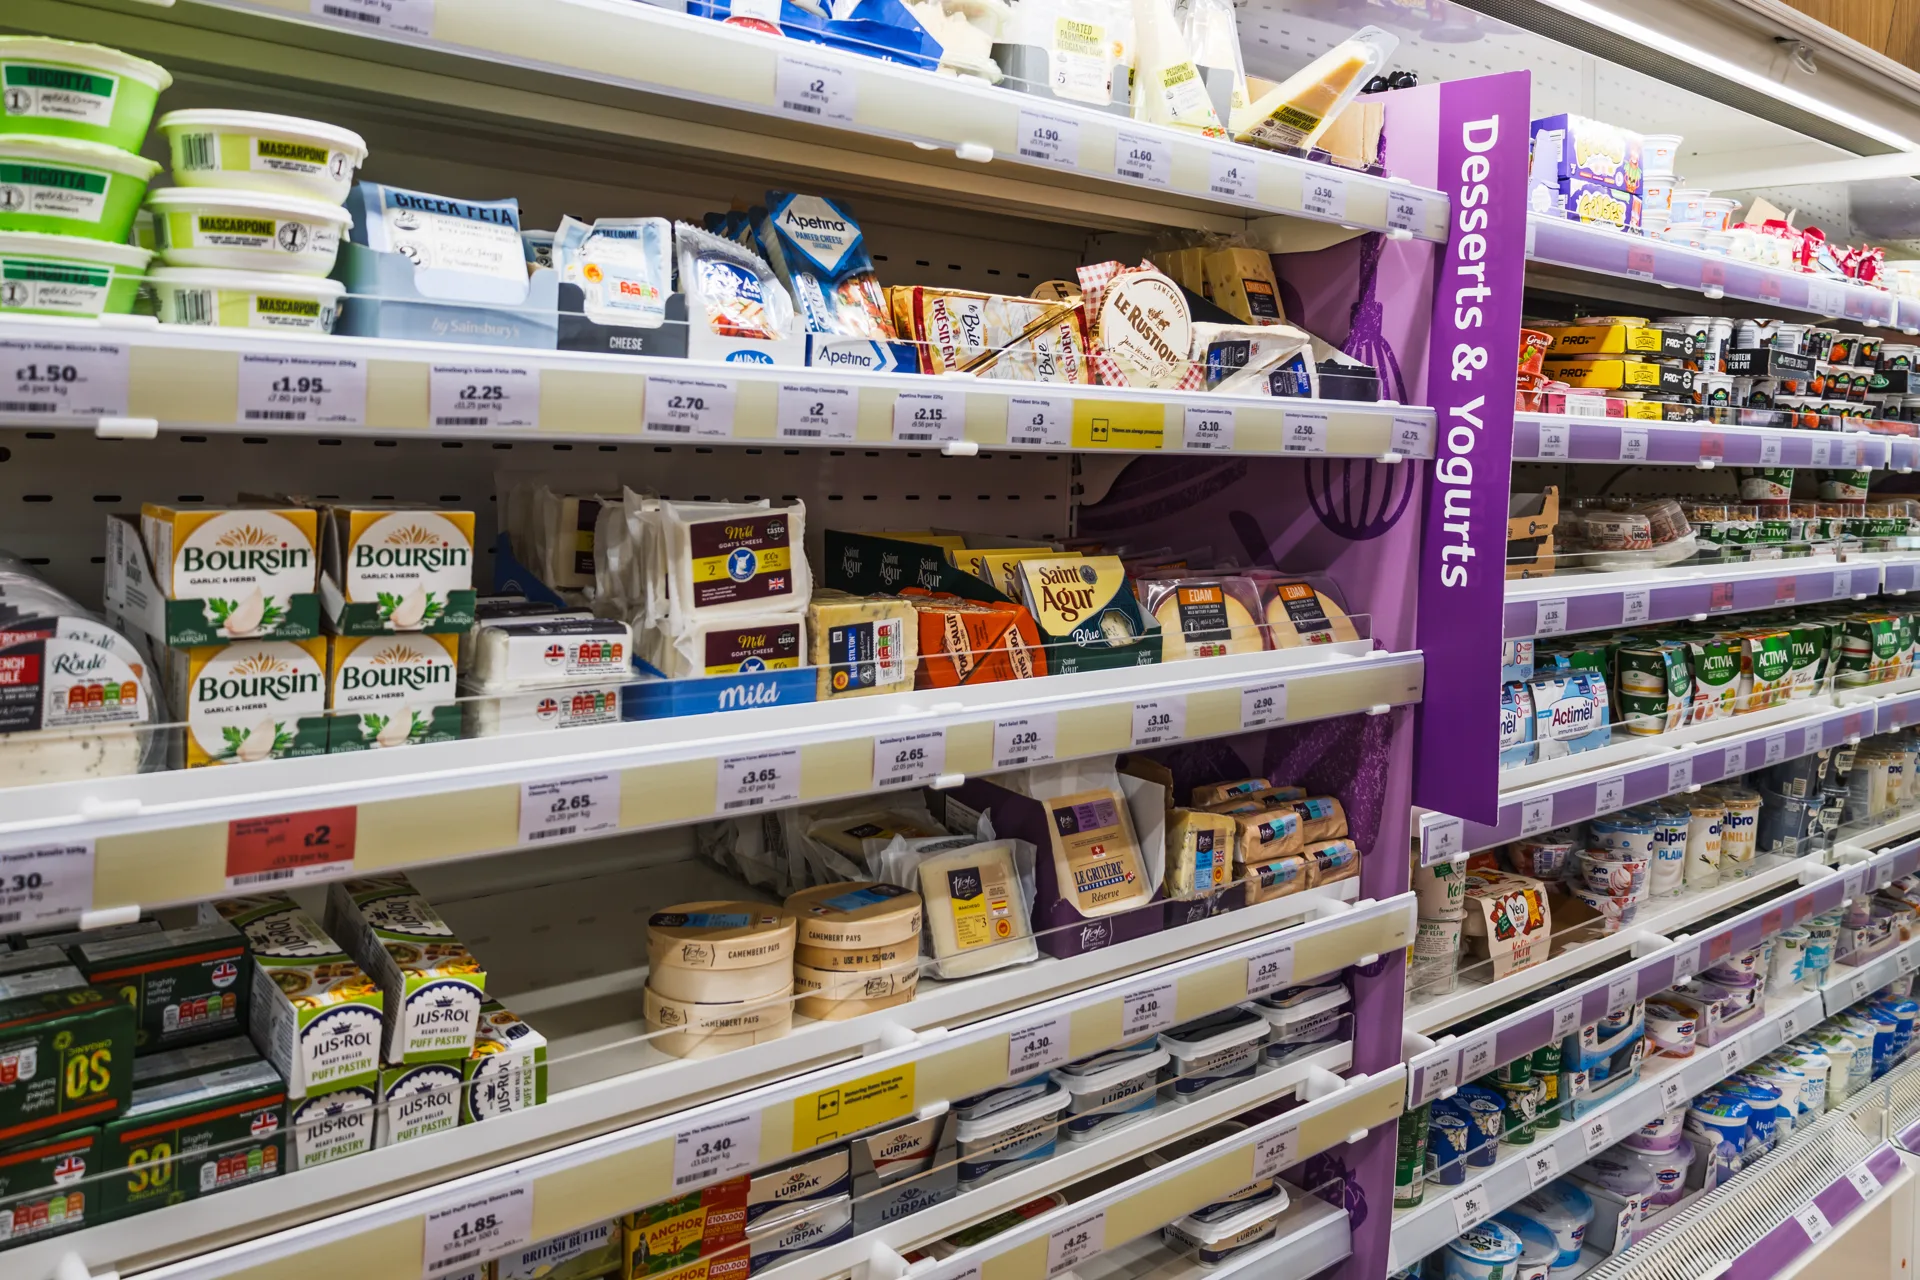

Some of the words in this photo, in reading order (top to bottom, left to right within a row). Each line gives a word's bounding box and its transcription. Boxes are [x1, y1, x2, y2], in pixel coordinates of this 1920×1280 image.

[1067, 21, 1092, 34] GRATED
[27, 67, 94, 93] RICOTTA
[810, 79, 824, 93] £2
[1034, 129, 1059, 142] £1.90
[258, 141, 328, 163] MASCARPONE
[1130, 148, 1152, 163] £1.60
[22, 165, 86, 190] RICOTTA
[1227, 167, 1237, 179] £4
[1314, 187, 1332, 198] £3.50
[200, 218, 274, 235] MASCARPONE
[786, 209, 846, 232] Apetina
[1454, 114, 1500, 330] Desserts
[795, 231, 819, 243] PANEER
[820, 234, 843, 246] CHEESE
[257, 298, 320, 315] MASCARPONE
[1114, 292, 1131, 316] LE
[1153, 283, 1184, 319] CAMEMBERT
[432, 317, 447, 336] by
[450, 318, 520, 340] Sainsbury's
[933, 299, 957, 369] PRÉSIDENT
[609, 336, 643, 350] CHEESE
[819, 346, 872, 366] Apetina
[1451, 342, 1489, 382] &
[1728, 362, 1737, 370] PER
[17, 365, 77, 383] £1.50
[273, 378, 323, 393] £1.95
[460, 386, 503, 400] £2.25
[668, 397, 704, 410] £2.70
[810, 403, 824, 416] £2
[915, 409, 942, 421] £2.15
[1032, 414, 1043, 425] £3
[1199, 421, 1219, 431] £3.10
[1295, 426, 1313, 435] £2.50
[1402, 431, 1419, 440] £2.75
[1436, 394, 1486, 588] Yogurts
[725, 526, 753, 539] Mild
[719, 541, 739, 549] GOAT'S
[741, 538, 763, 546] CHEESE
[709, 565, 715, 576] 2
[920, 558, 938, 572] Saint
[917, 571, 942, 591] Agur
[1039, 566, 1081, 585] Saint
[1189, 590, 1213, 602] EDAM
[1286, 586, 1307, 598] EDAM
[1042, 586, 1094, 622] Agur
[947, 616, 962, 649] SALUT
[1073, 628, 1100, 648] Blue
[738, 635, 766, 648] Mild
[731, 649, 751, 657] GOAT'S
[752, 647, 773, 655] CHEESE
[1759, 650, 1788, 666] ACTIVIA
[1704, 655, 1733, 670] ACTIVIA
[719, 682, 780, 708] Mild
[1254, 698, 1273, 708] £2.90
[1148, 714, 1170, 725] £3.10
[1552, 701, 1593, 727] Actimel
[1012, 732, 1037, 745] £3.20
[896, 748, 924, 762] £2.65
[743, 769, 775, 784] £3.65
[551, 795, 590, 812] £2.65
[1723, 813, 1754, 829] alpro
[304, 826, 330, 847] £2
[1654, 828, 1686, 846] alpro
[1658, 849, 1683, 861] PLAIN
[1074, 871, 1085, 885] LE
[1086, 862, 1122, 881] GRUYÈRE
[1080, 876, 1123, 891] SWITZERLAND
[1091, 889, 1119, 903] Réserve
[1509, 903, 1525, 915] Yeo
[809, 931, 842, 942] CAMEMBERT
[843, 933, 861, 942] PAYS
[728, 945, 765, 959] CAMEMBERT
[766, 942, 780, 955] PAYS
[1259, 962, 1278, 975] £3.25
[1135, 1001, 1157, 1014] £4.10
[411, 1036, 433, 1047] PUFF
[435, 1034, 467, 1046] PASTRY
[1024, 1037, 1049, 1052] £4.30
[312, 1067, 336, 1080] PUFF
[338, 1058, 371, 1075] PASTRY
[1102, 1082, 1144, 1106] LURPAK
[696, 1138, 731, 1157] £3.40
[880, 1139, 920, 1157] LURPAK
[1266, 1143, 1286, 1157] £4.25
[1537, 1159, 1547, 1169] 95p
[1657, 1172, 1679, 1180] FAGE
[775, 1177, 820, 1198] LURPAK
[882, 1194, 936, 1220] LURPAK
[1466, 1200, 1477, 1210] 95p
[707, 1211, 745, 1225] £100,000
[453, 1214, 496, 1239] £1.85
[650, 1217, 703, 1243] ANCHOR
[1236, 1225, 1263, 1243] LURPAK
[569, 1226, 608, 1248] BUTTER
[779, 1225, 824, 1248] LURPAK
[1064, 1232, 1088, 1250] £4.25
